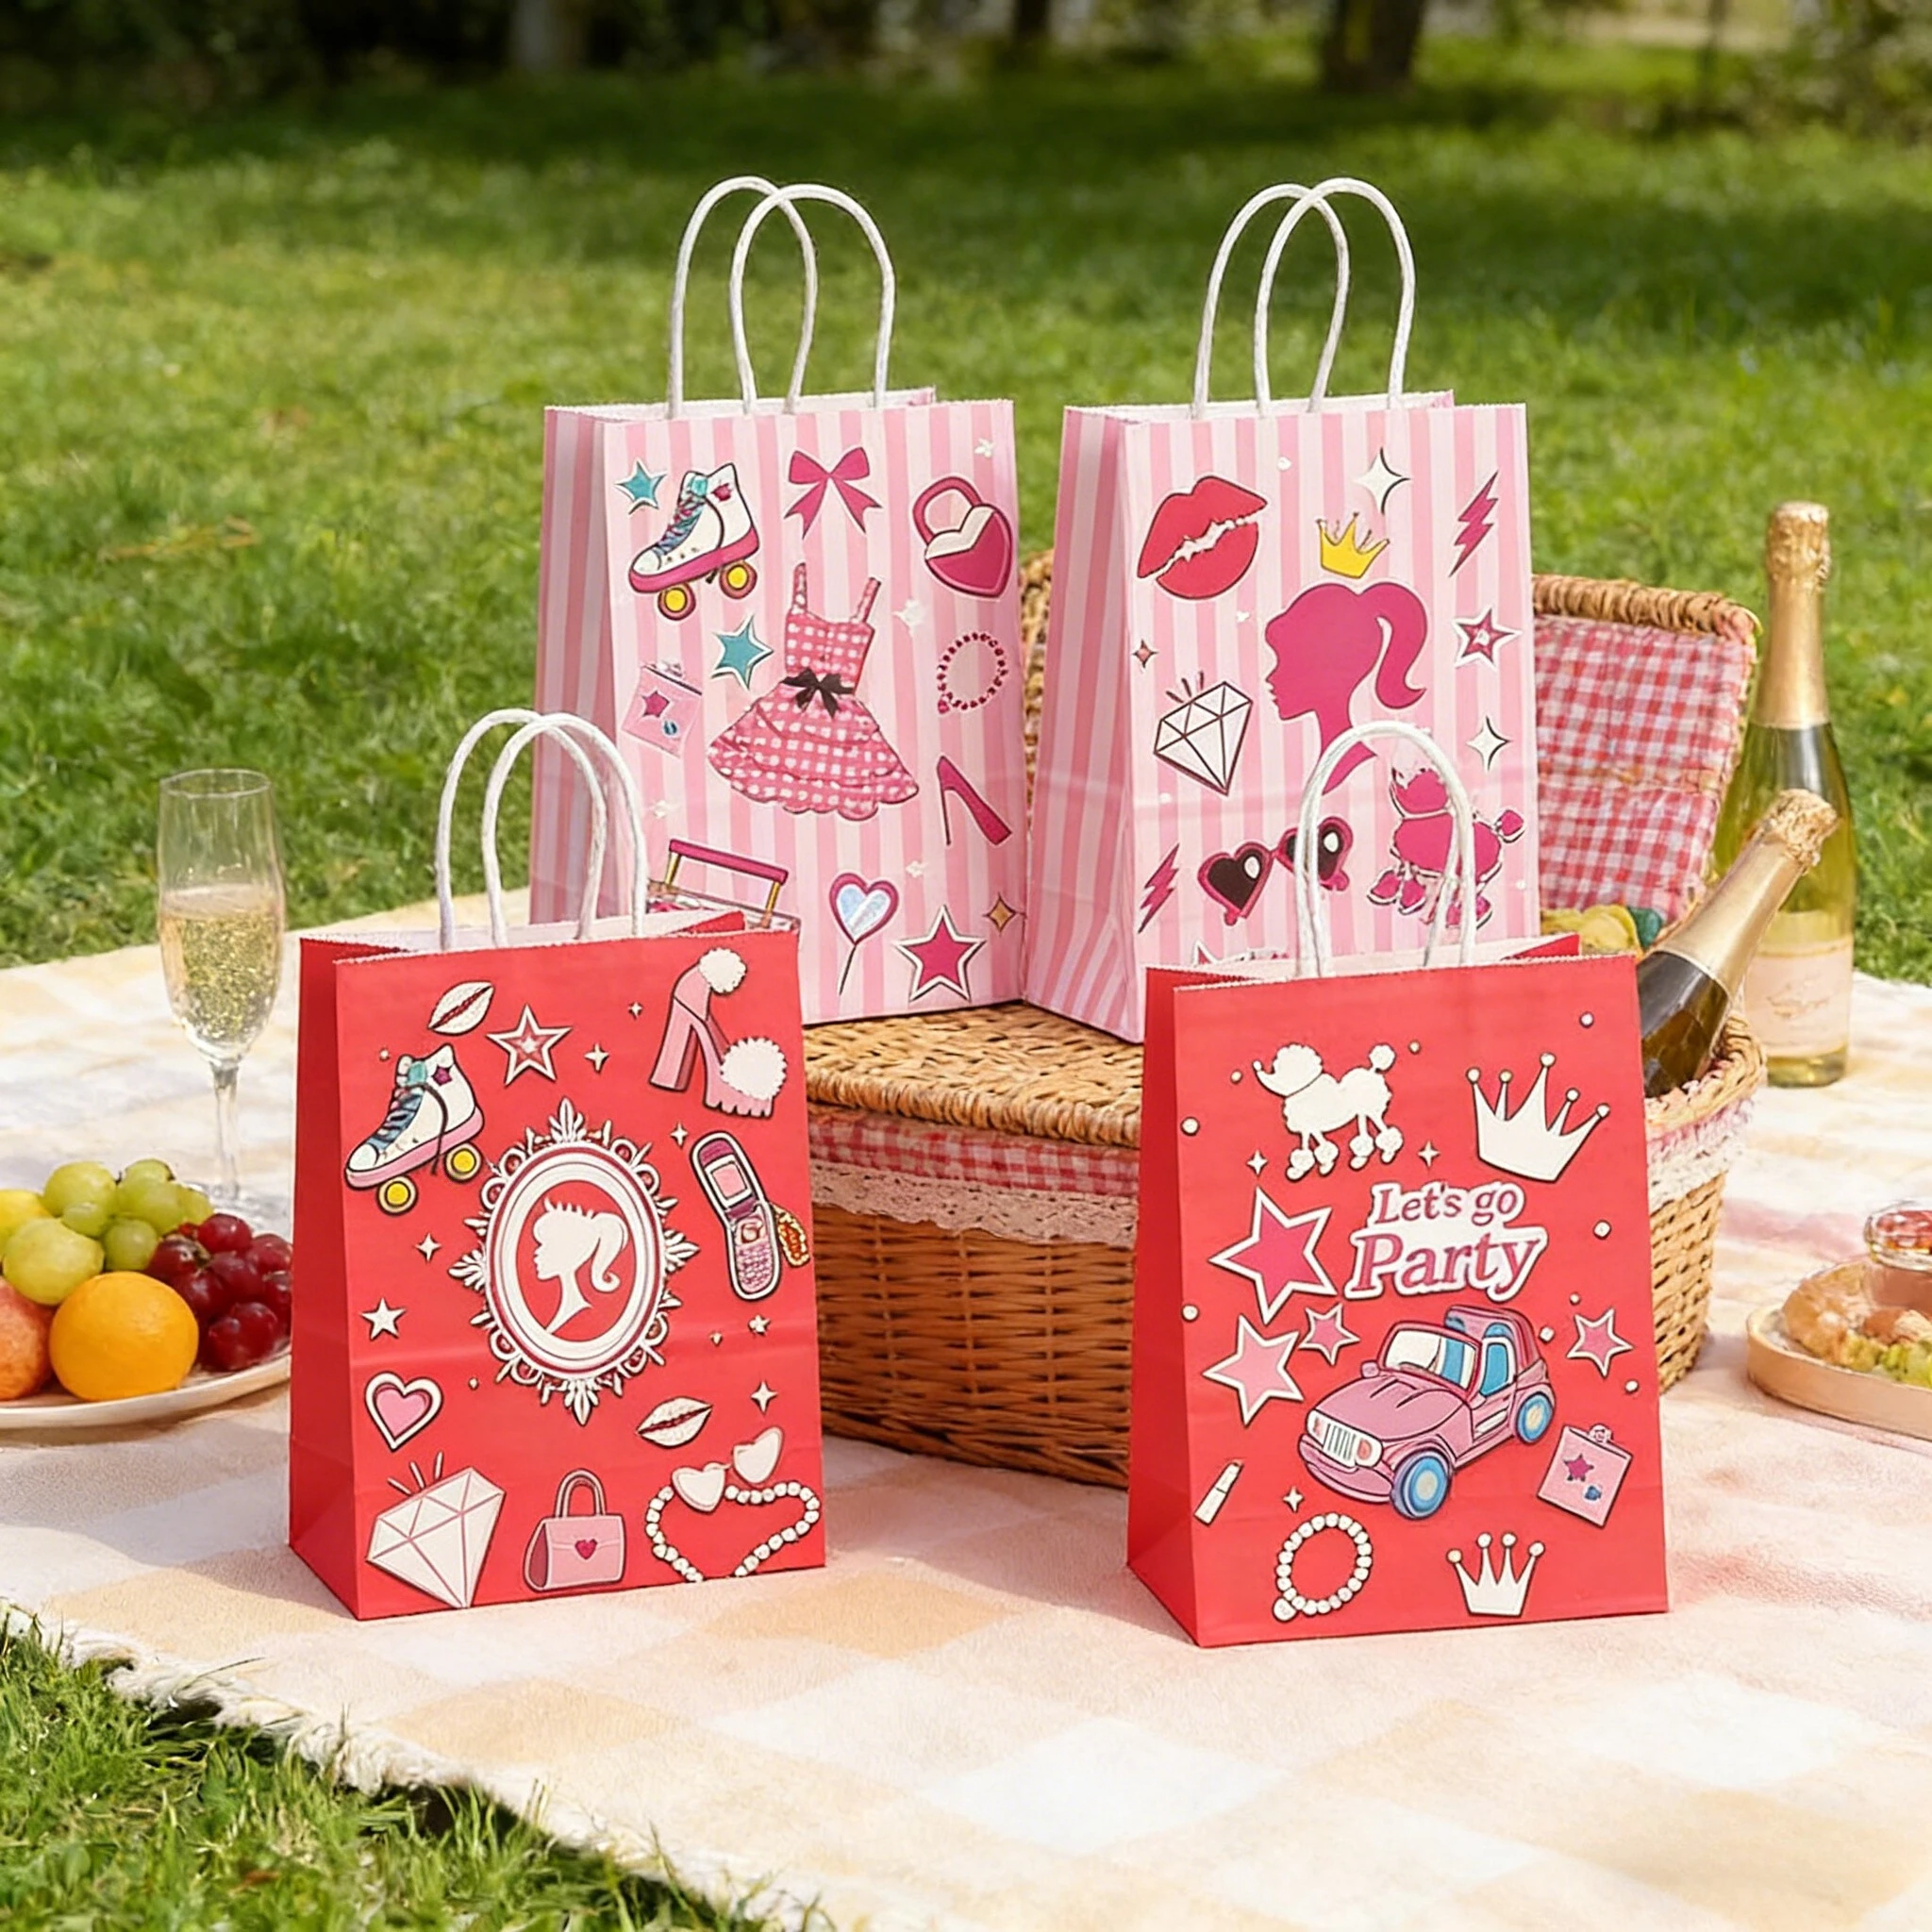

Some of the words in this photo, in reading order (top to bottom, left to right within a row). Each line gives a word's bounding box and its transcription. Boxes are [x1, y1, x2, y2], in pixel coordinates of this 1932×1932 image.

[1374, 1183, 1462, 1224] Let's
[1472, 1188, 1519, 1227] go
[1351, 1231, 1542, 1295] Party
